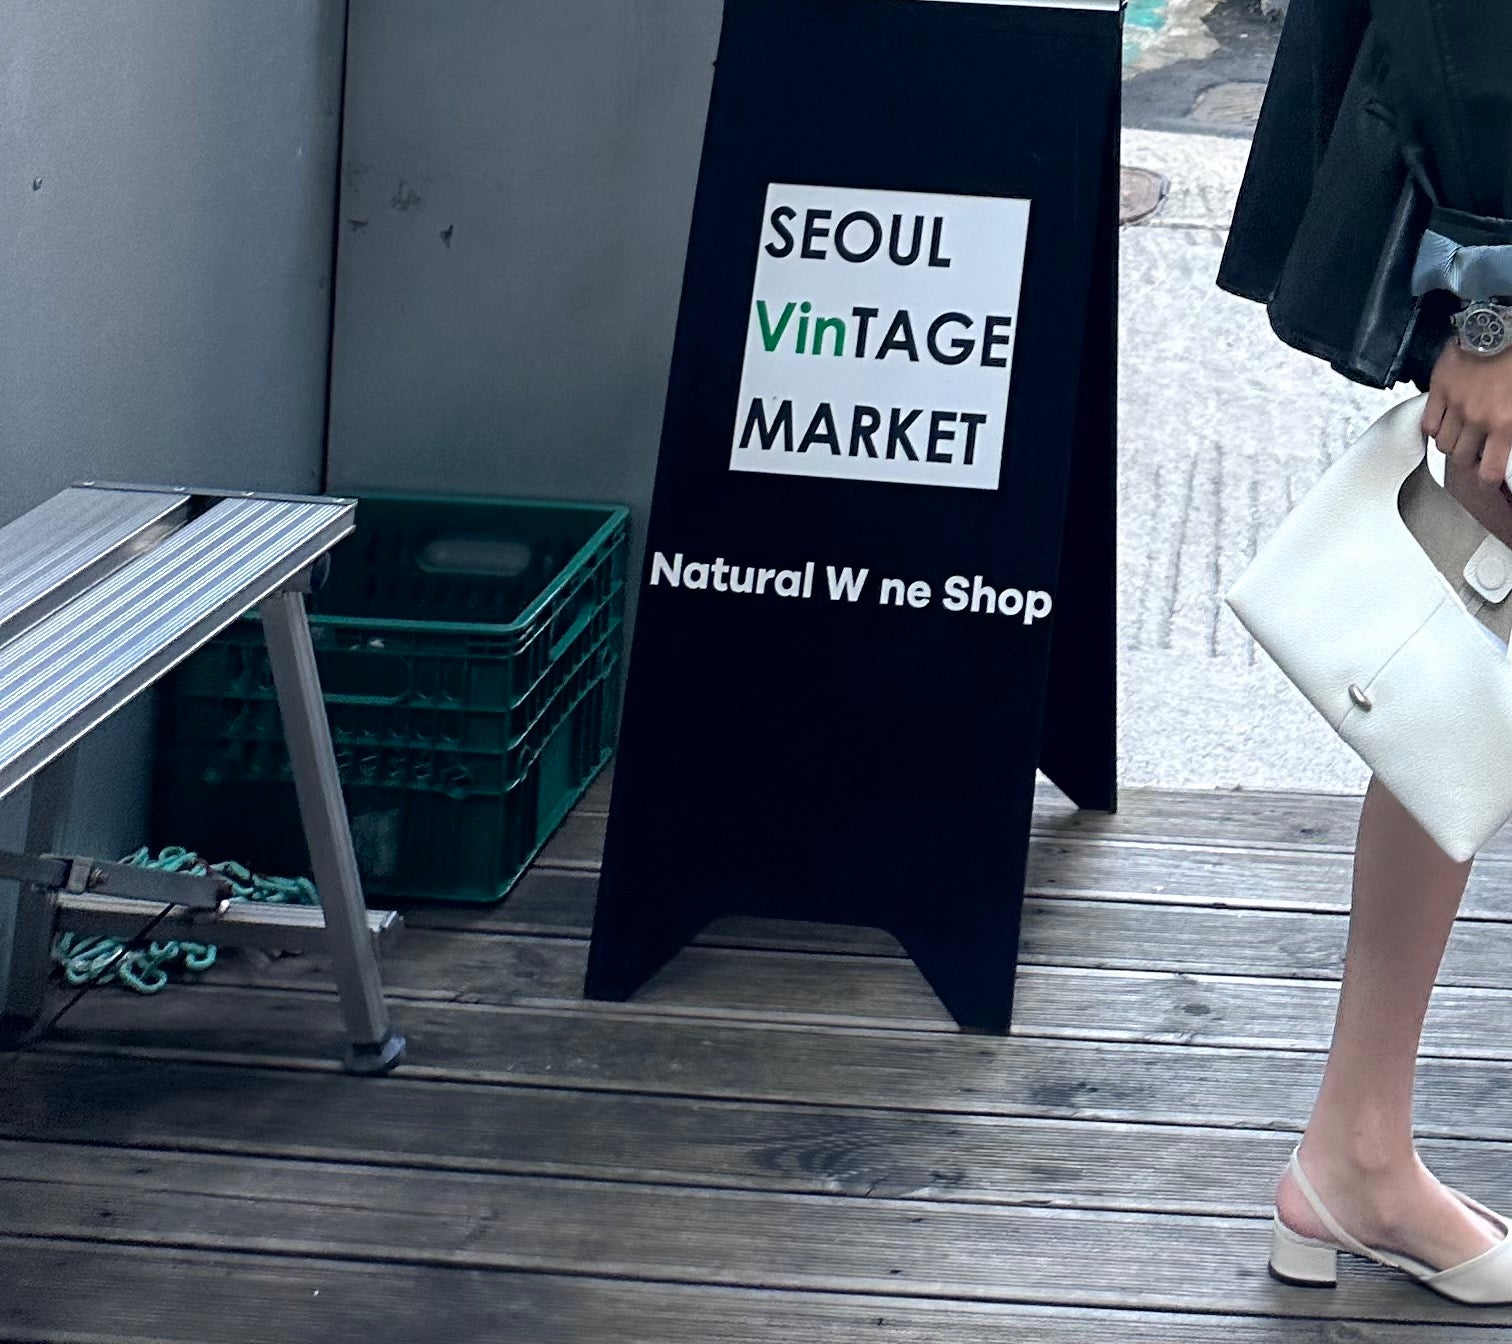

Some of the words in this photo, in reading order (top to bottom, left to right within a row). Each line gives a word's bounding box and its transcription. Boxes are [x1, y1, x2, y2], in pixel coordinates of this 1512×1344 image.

[764, 205, 952, 268] SEOUL
[756, 299, 1013, 368] VinTAGE
[738, 396, 987, 466] MARKET
[649, 551, 815, 599] Natural
[827, 566, 932, 609] Wne
[941, 574, 1053, 625] Shop
